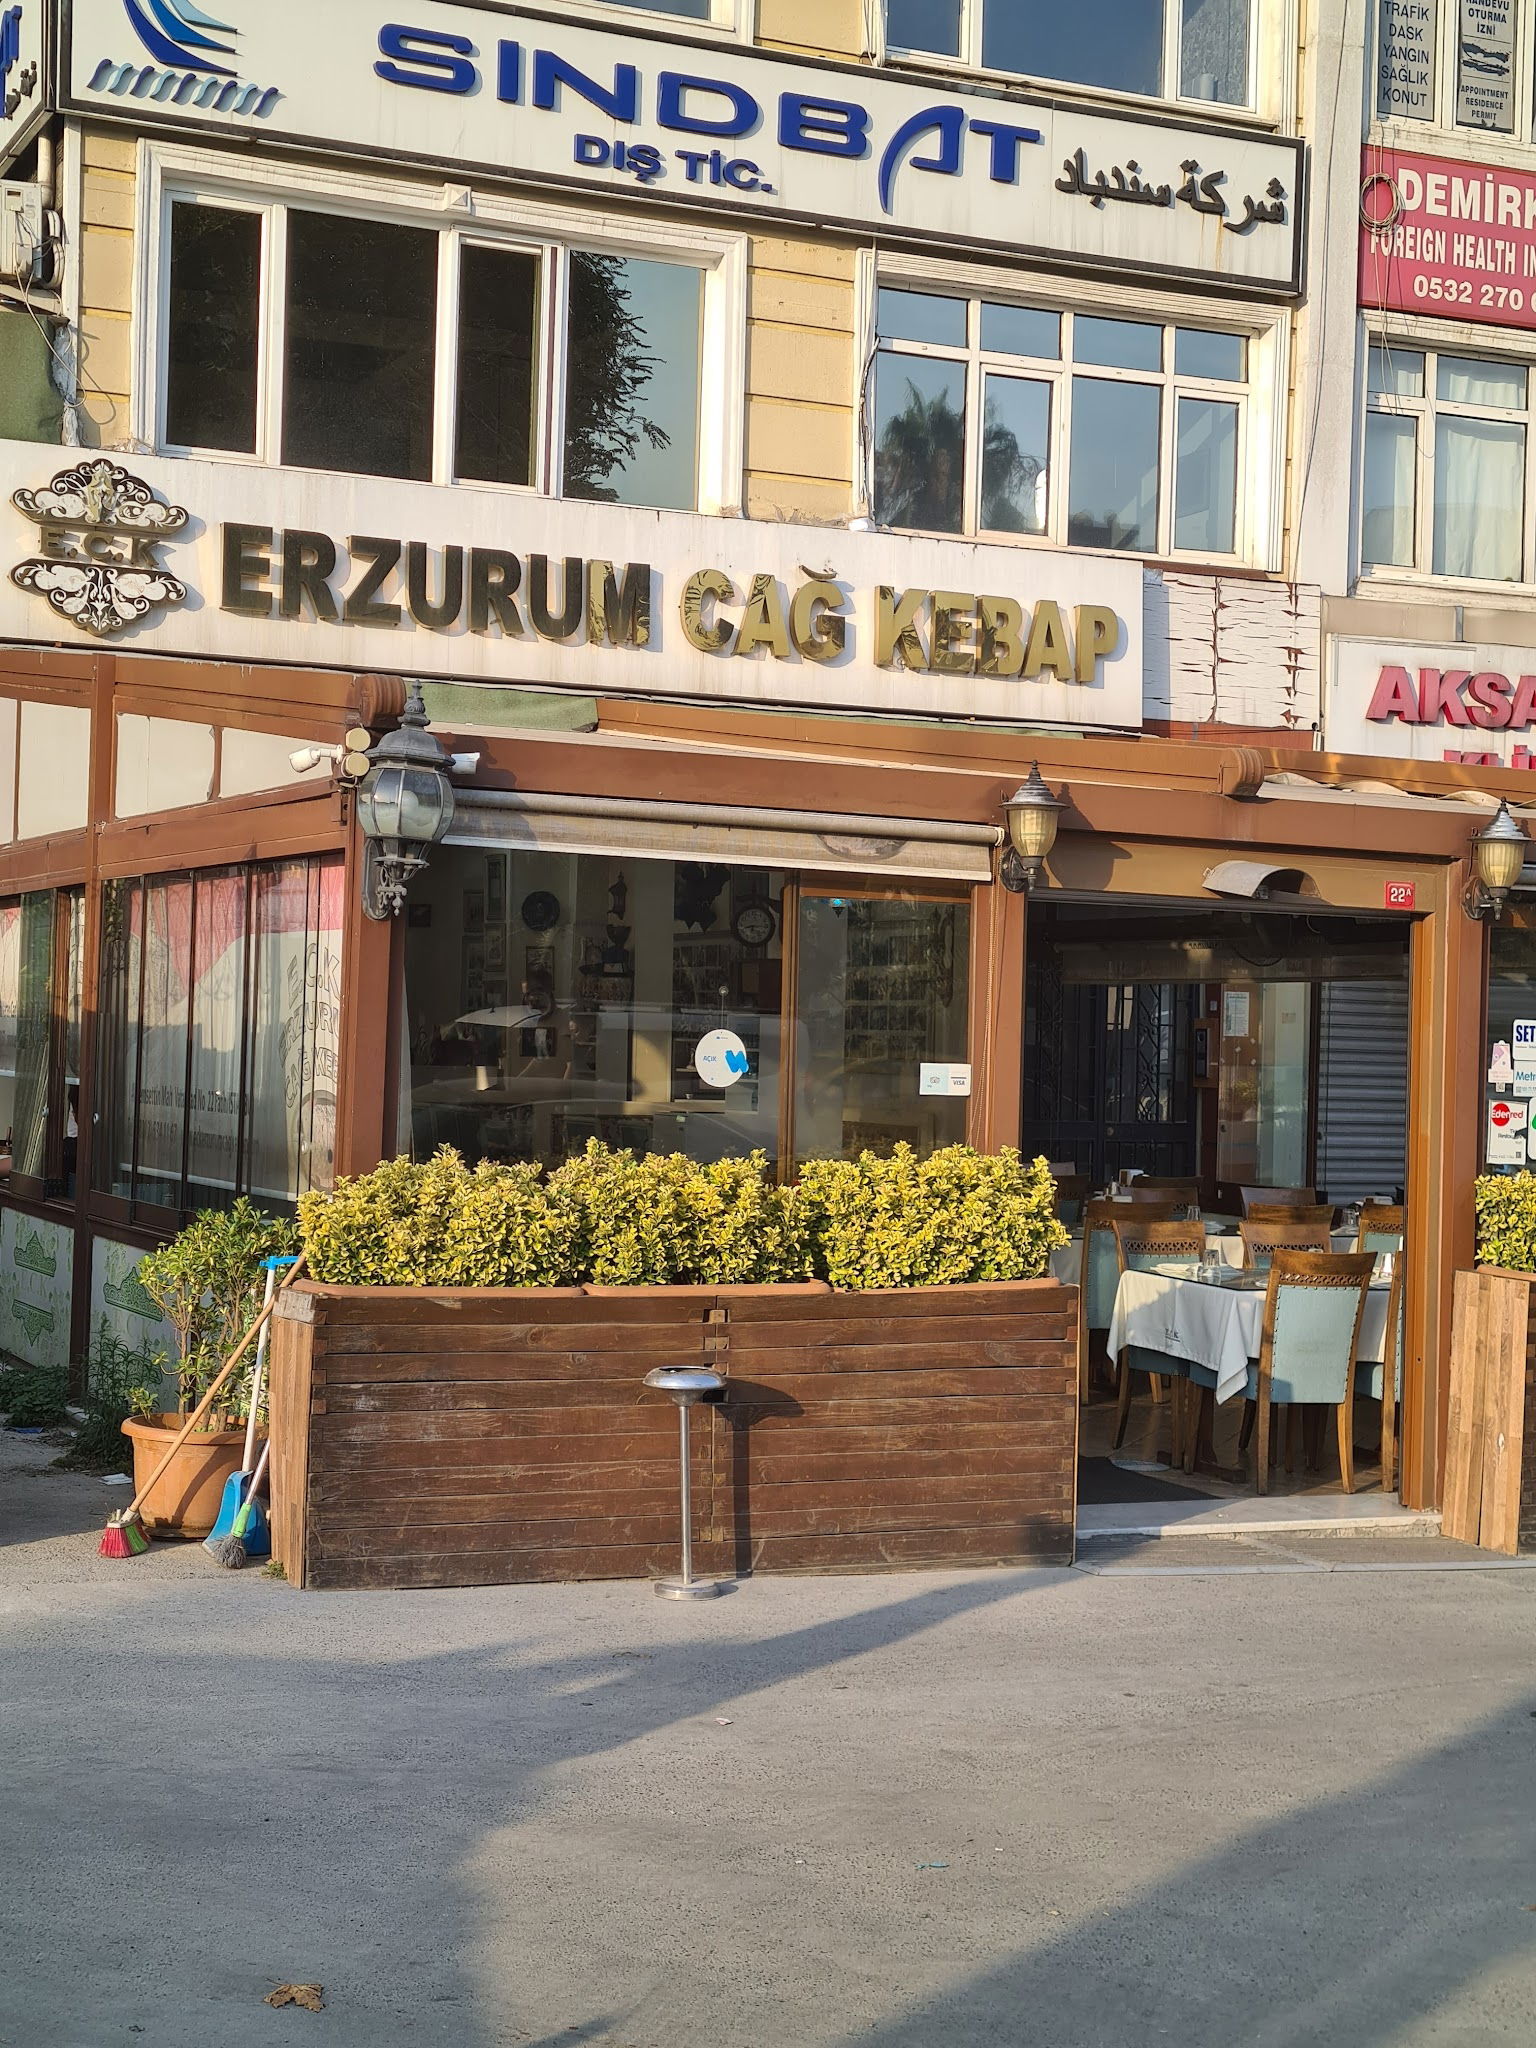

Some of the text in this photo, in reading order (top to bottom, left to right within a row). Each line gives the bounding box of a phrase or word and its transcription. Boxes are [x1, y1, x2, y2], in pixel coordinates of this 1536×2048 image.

[1384, 2, 1430, 22] TRAFİK
[1468, 8, 1507, 23] OTURMA
[1389, 23, 1424, 41] DASK
[1476, 23, 1496, 36] İZNİ
[1383, 43, 1430, 64] YANGIN
[1381, 64, 1429, 86] SAĞLIK
[1382, 87, 1428, 107] KONUT
[1460, 85, 1509, 100] APPOINTMENT
[1465, 97, 1504, 110] RESIDENCE
[373, 23, 1041, 213] SINDBAT
[1471, 110, 1497, 121] PERMIT
[573, 133, 773, 191] DIŞ TİC.
[1054, 146, 1285, 234] شركة سندباد
[1370, 223, 1447, 265] FOREIGN
[1452, 232, 1516, 275] HEALTH
[1413, 274, 1473, 304] 0532
[1479, 284, 1524, 311] 270
[219, 521, 651, 647] ERZURUM
[873, 584, 1119, 682] KEBAP
[1491, 1109, 1524, 1120] Edenred
